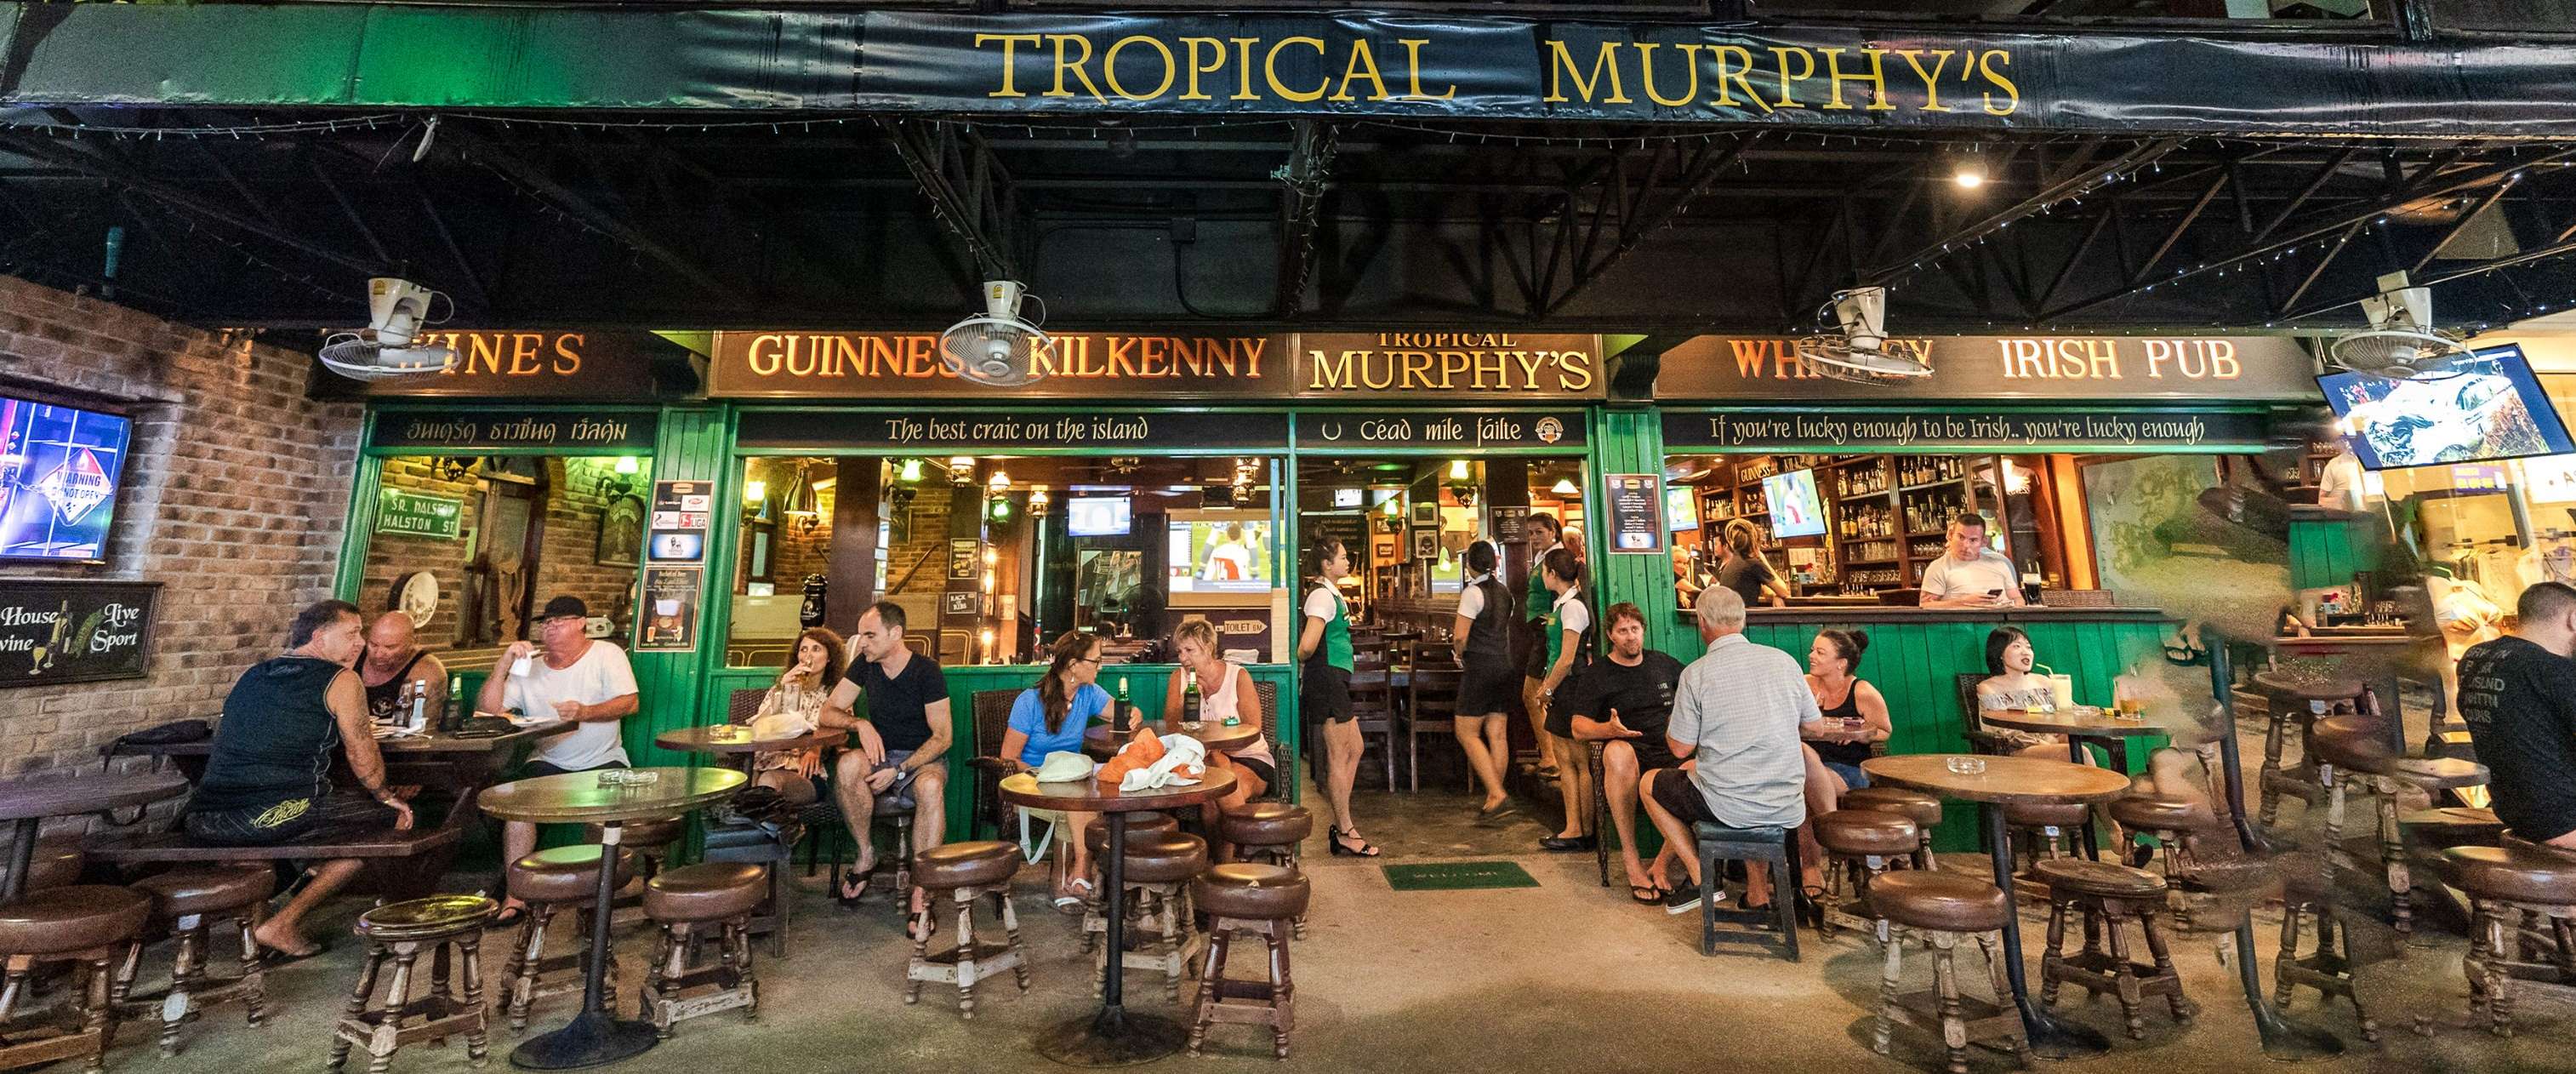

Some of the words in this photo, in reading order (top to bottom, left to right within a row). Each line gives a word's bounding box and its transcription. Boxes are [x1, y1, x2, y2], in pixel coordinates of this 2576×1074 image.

[974, 34, 1456, 104] TROPICAL
[1543, 40, 2020, 116] MURPHY'S
[398, 332, 586, 376] INES
[1376, 333, 1517, 348] TROPICAL
[1026, 335, 1268, 379] KILKENNY
[1309, 350, 1593, 391] MURPHY'S
[1728, 340, 1934, 380] WHIEY
[1998, 340, 2123, 380] IRISH
[2142, 340, 2243, 380] PUB
[886, 418, 922, 444] The
[929, 417, 967, 440] best
[973, 416, 1020, 440] craic
[1025, 424, 1050, 440] on
[1056, 417, 1085, 444] the
[1091, 416, 1148, 441] island
[1361, 417, 1411, 441] Céad
[1426, 417, 1463, 441] míle
[1477, 416, 1522, 448] fáilte
[1709, 414, 1725, 445] If
[1733, 419, 1791, 445] you're
[1797, 415, 1848, 445] lucky
[1853, 416, 1917, 445] enough
[1923, 420, 1941, 438] to
[1946, 416, 1965, 438] be
[1969, 415, 2020, 439] Irish..
[2025, 419, 2082, 445] you're
[2087, 415, 2137, 445] lucky
[2142, 416, 2205, 445] enough
[64, 488, 79, 499] NOT
[384, 514, 431, 530] HALSTON
[1, 606, 60, 626] House
[104, 603, 140, 627] Live
[1225, 623, 1250, 631] TOILET
[90, 628, 138, 653] Sport
